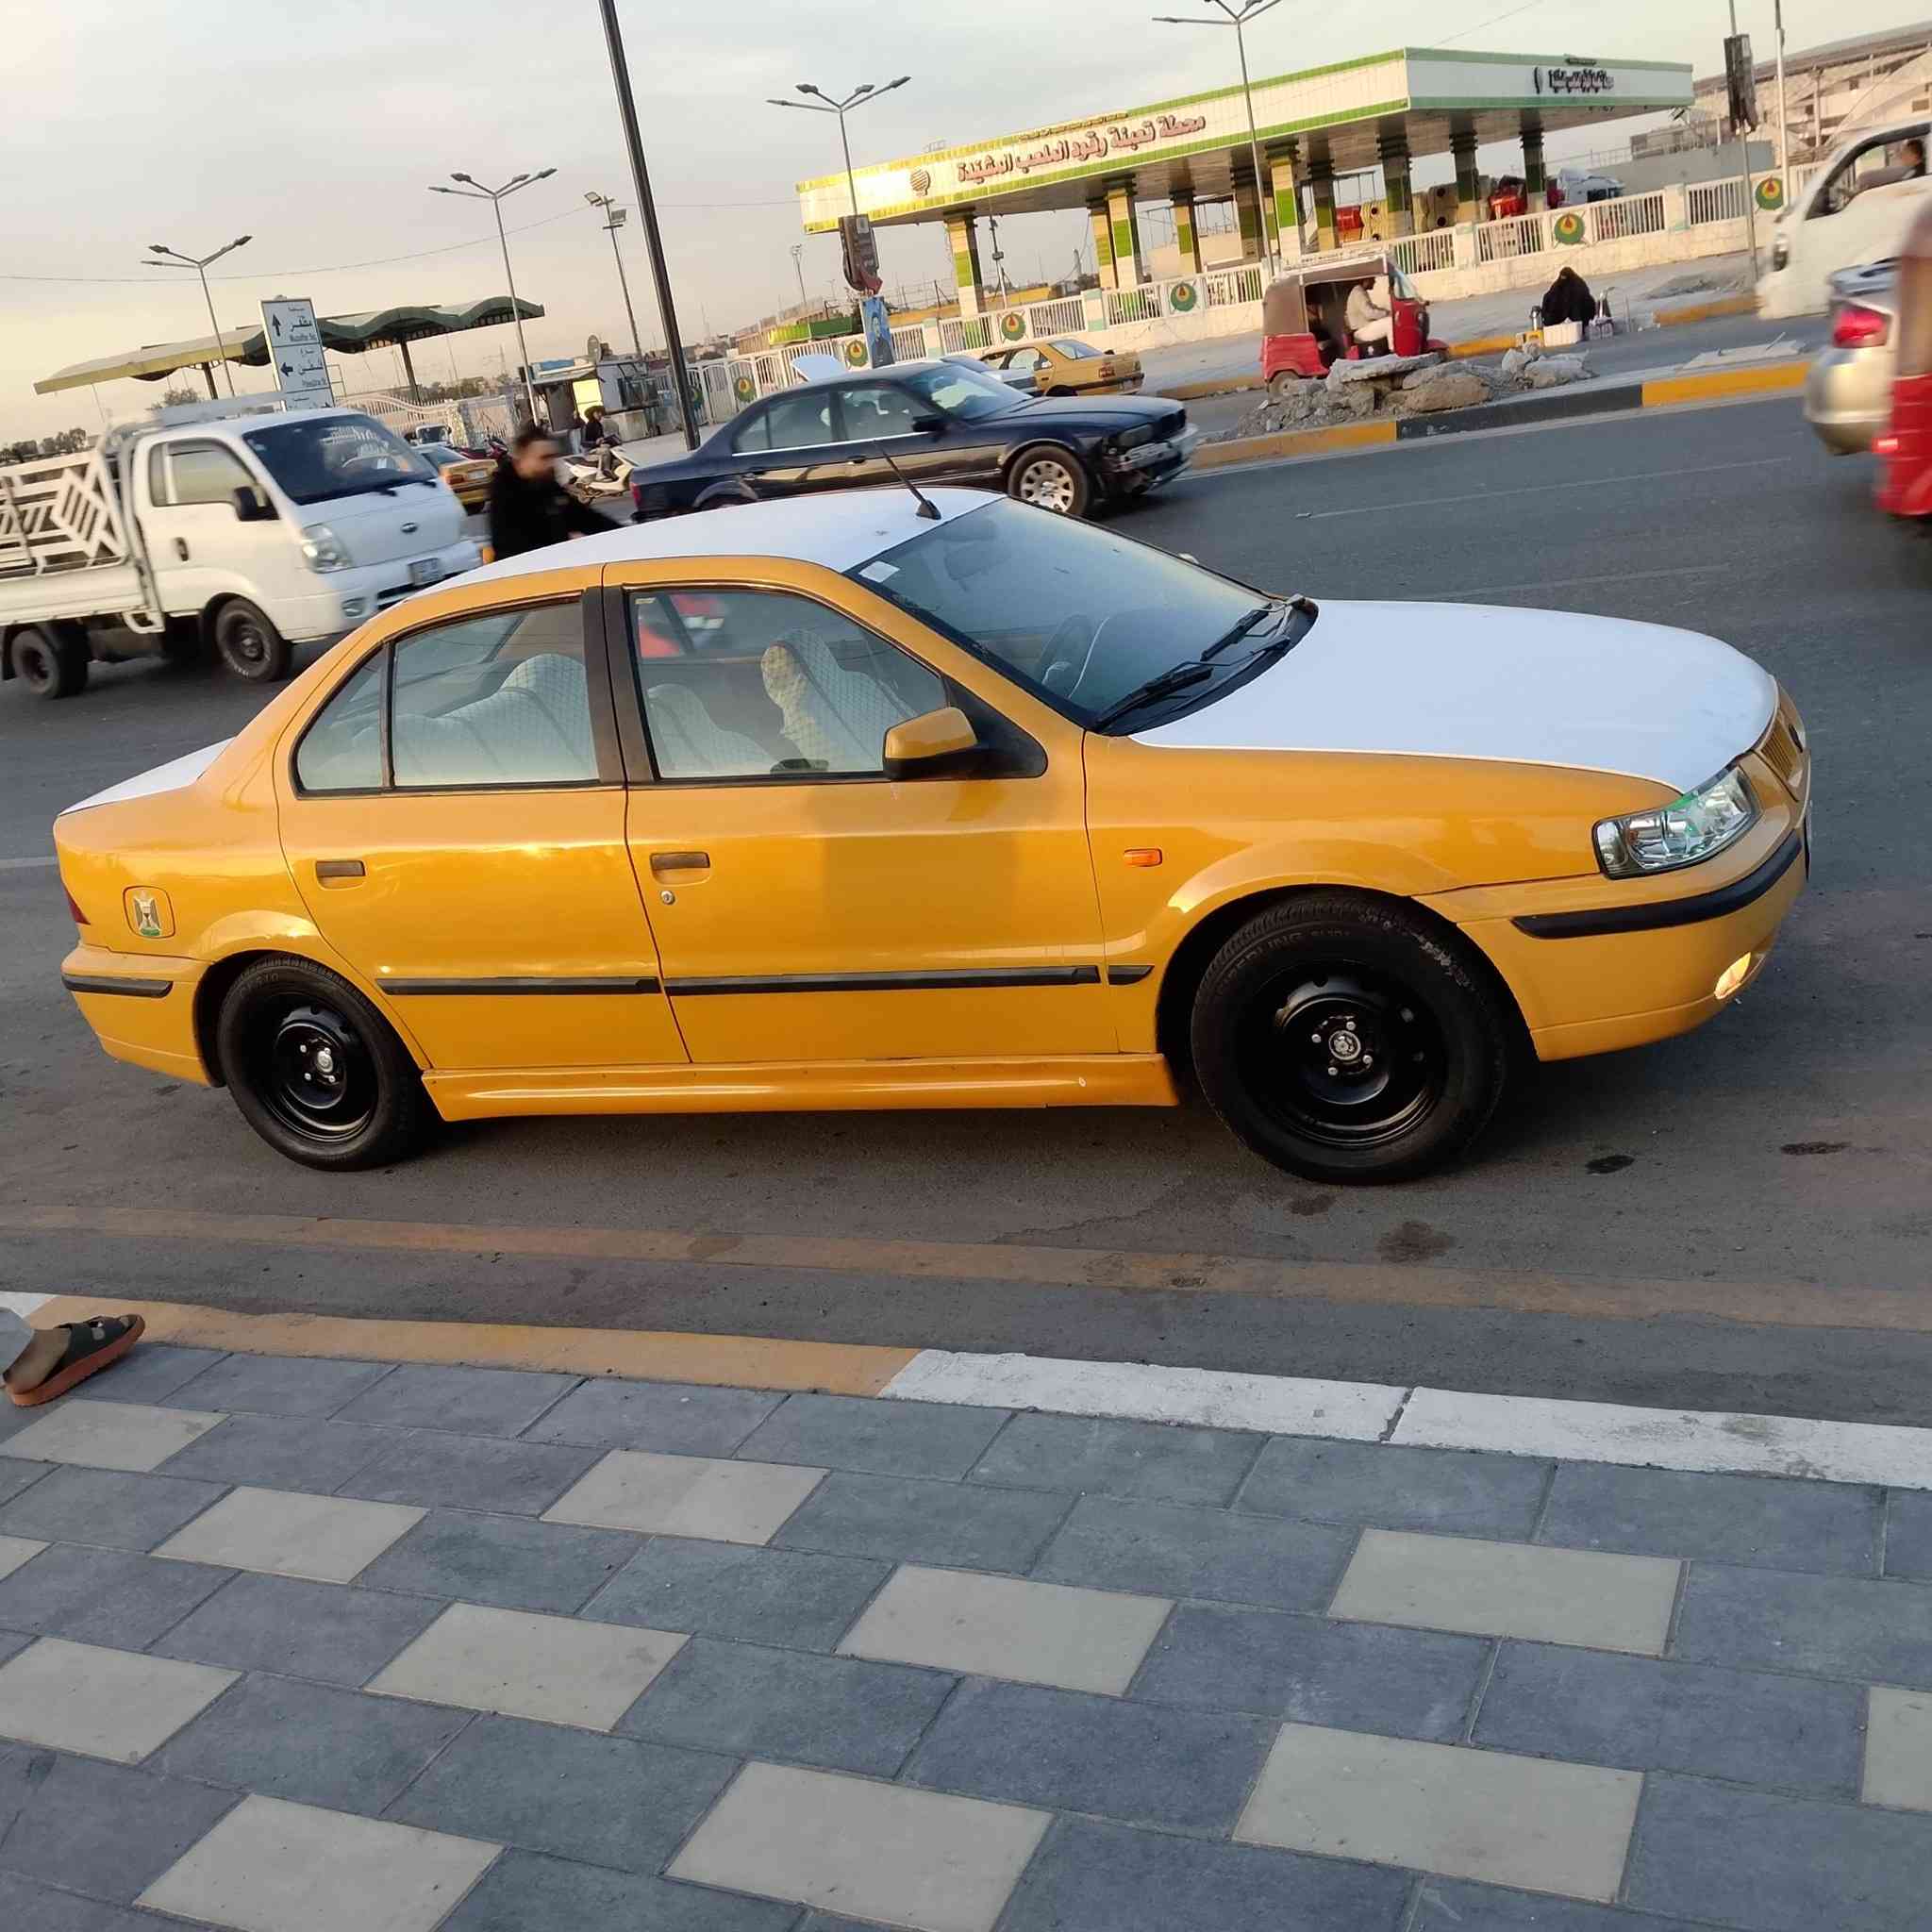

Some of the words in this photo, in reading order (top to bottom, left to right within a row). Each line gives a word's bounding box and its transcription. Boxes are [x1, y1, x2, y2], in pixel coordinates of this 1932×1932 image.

[1108, 121, 1156, 150] تعبئة
[1157, 114, 1207, 138] محطة
[1016, 140, 1070, 174] الملعب
